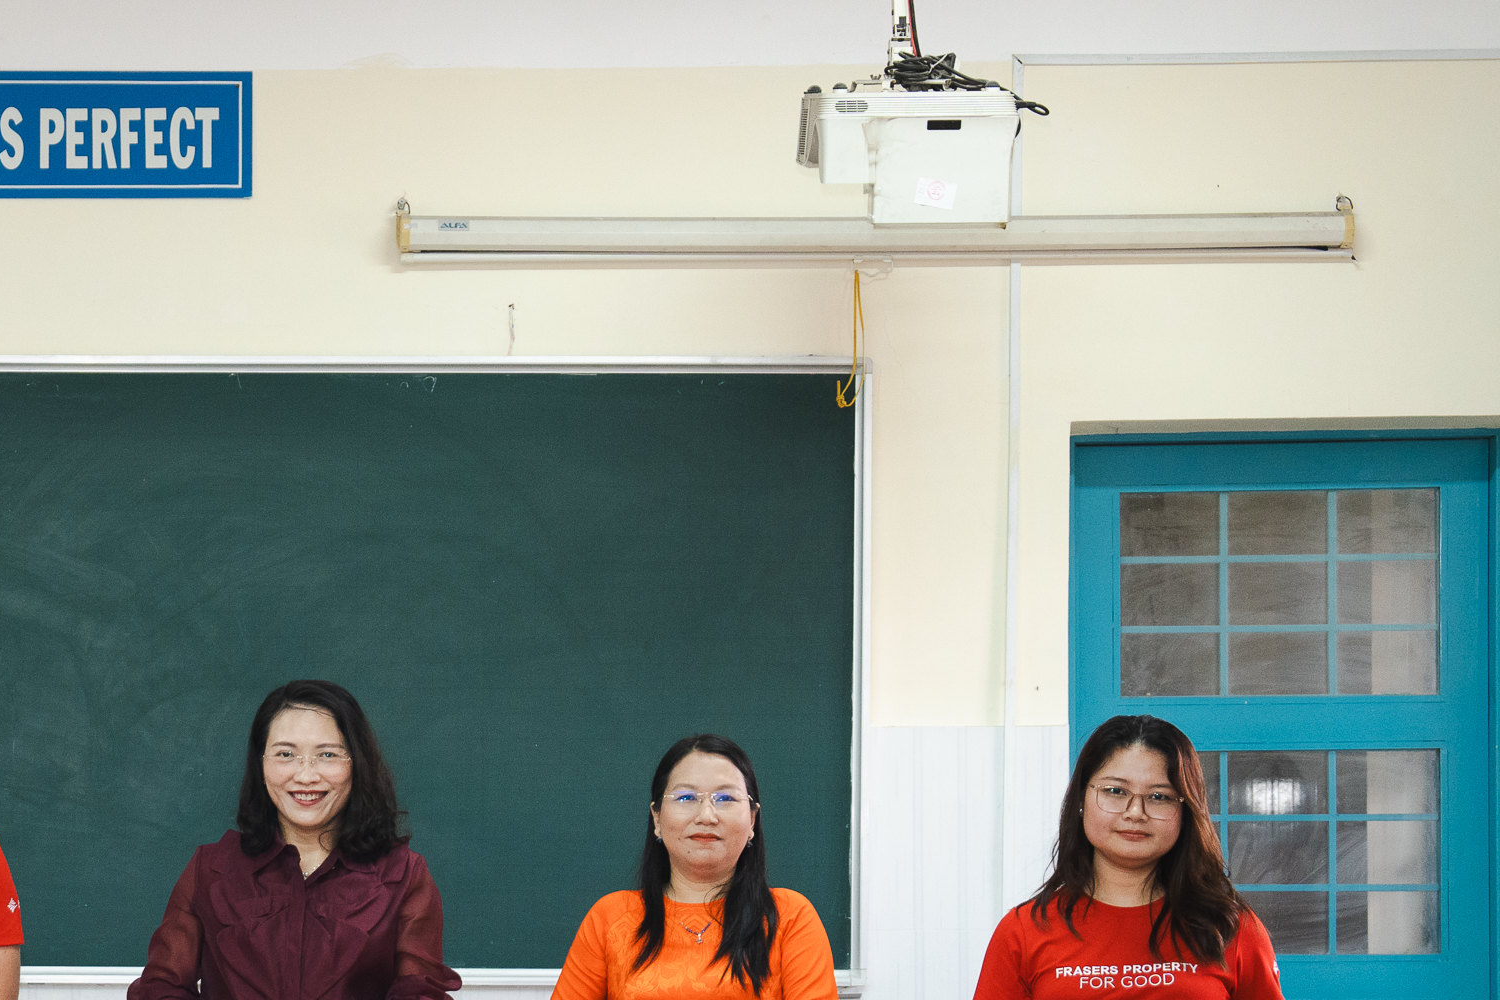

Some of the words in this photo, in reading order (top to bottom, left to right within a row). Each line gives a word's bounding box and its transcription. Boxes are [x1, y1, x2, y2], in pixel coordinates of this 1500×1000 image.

[39, 106, 220, 169] PERFECT
[1055, 965, 1119, 979] FRASERS
[1123, 961, 1198, 974] PROPERTY
[1080, 976, 1116, 989] FOR
[1121, 972, 1176, 988] GOOD
